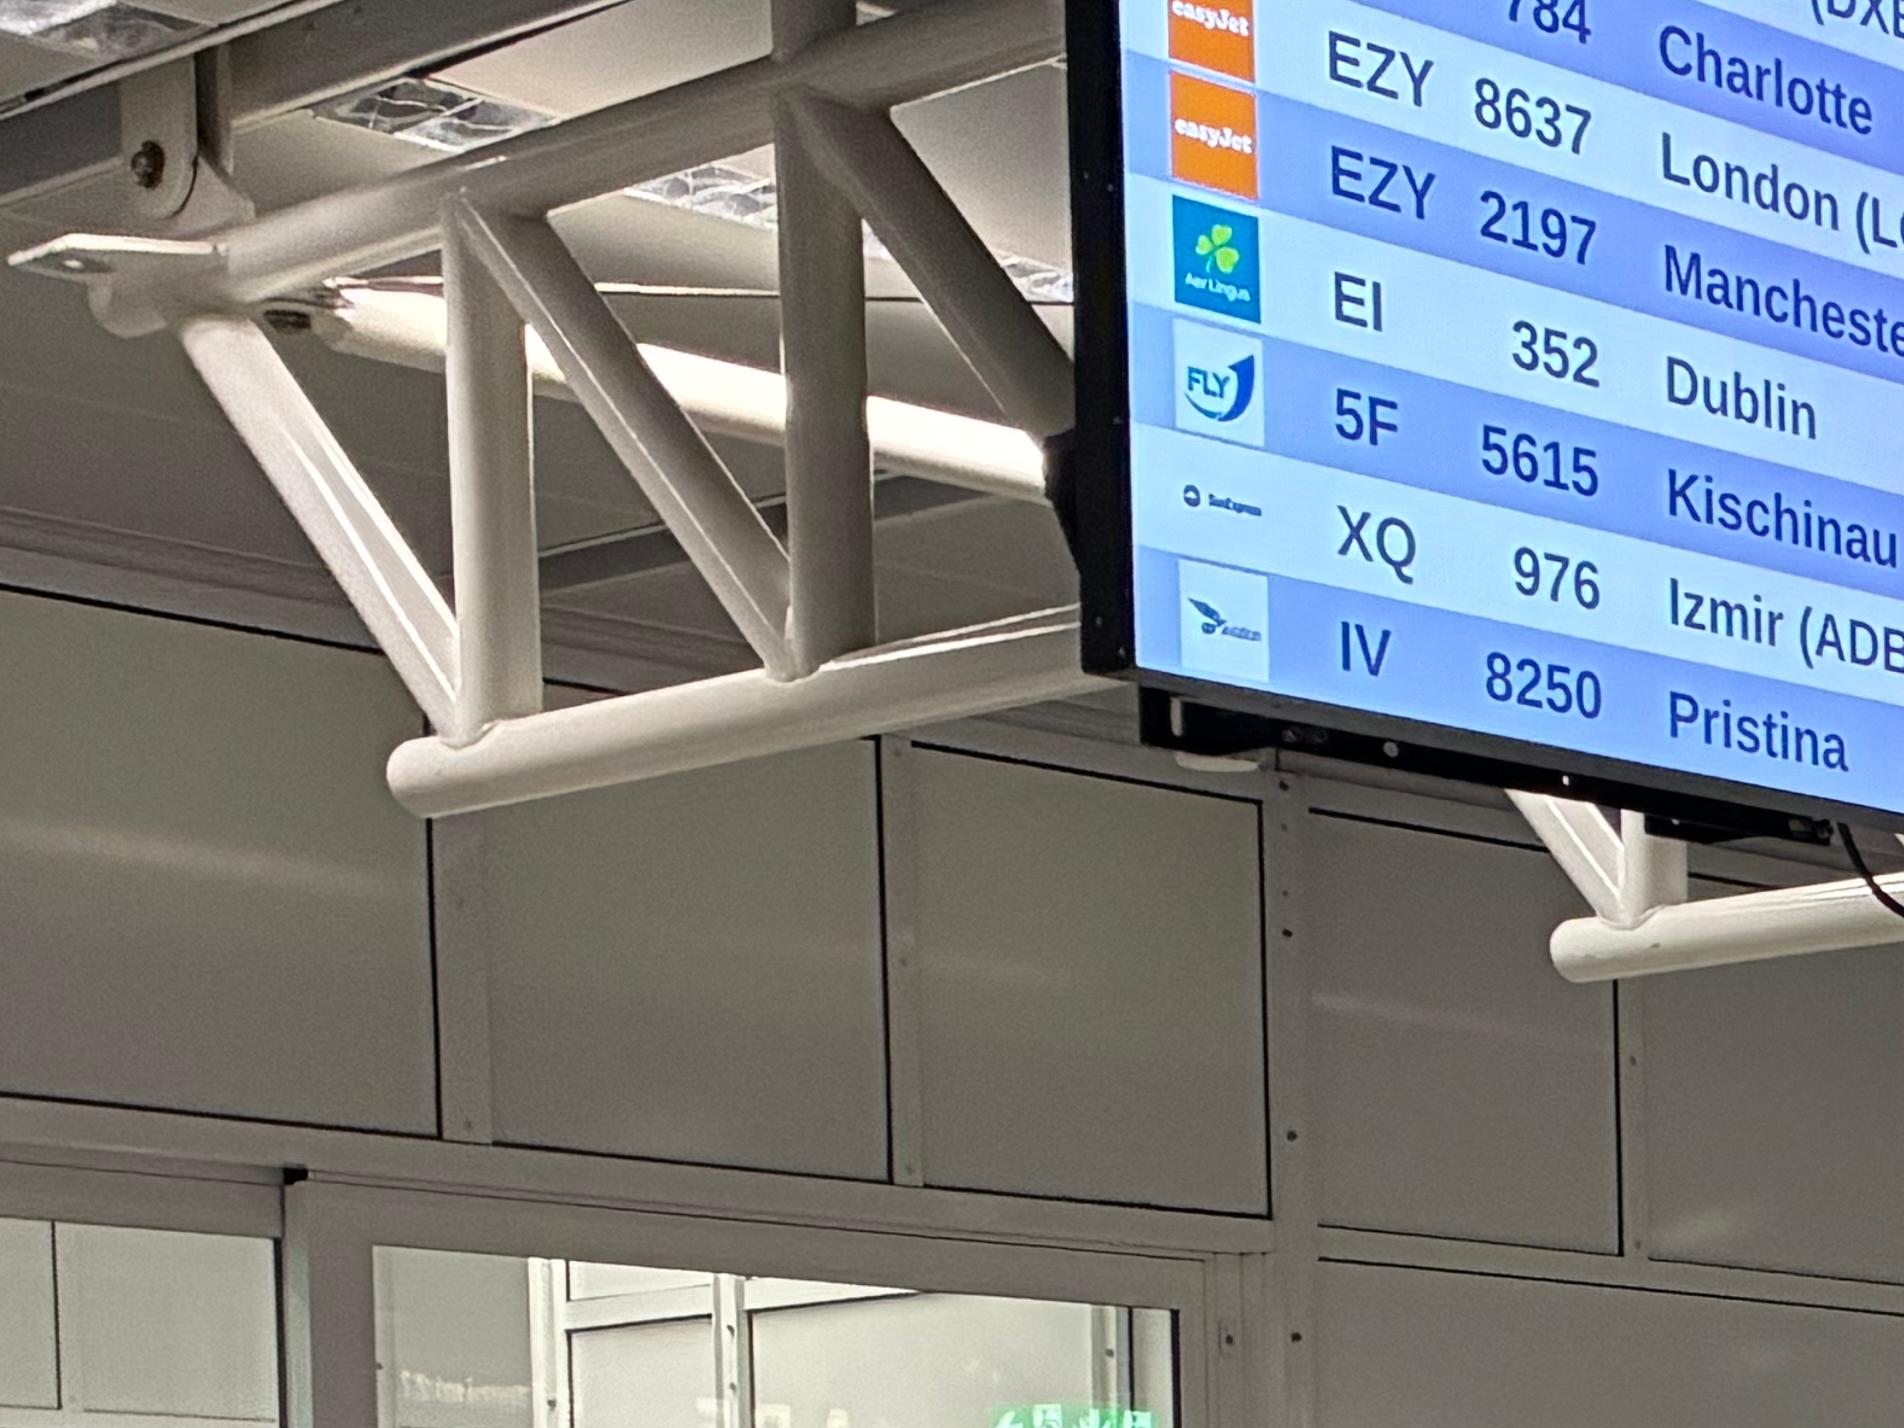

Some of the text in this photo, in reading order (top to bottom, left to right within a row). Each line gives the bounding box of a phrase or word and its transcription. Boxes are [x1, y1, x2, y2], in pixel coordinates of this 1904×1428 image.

[1171, 0, 1250, 37] easyJet
[1658, 24, 1873, 136] Charlotte
[1173, 117, 1254, 155] easyJet
[1327, 30, 1435, 108] EZY
[1473, 77, 1592, 155] 8637
[1661, 131, 1840, 232] London
[1330, 144, 1437, 220] EZY
[1479, 189, 1597, 266] 2197
[1187, 365, 1229, 400] FLY
[1333, 271, 1818, 440] EI 352 Dublin
[1334, 387, 1898, 569] 5F 5615 Kischinau
[1335, 504, 1417, 585] XQ
[1512, 546, 1601, 611] 976
[1668, 576, 1784, 648] Izmir
[1340, 620, 1849, 773] IV 8250 Pristina
